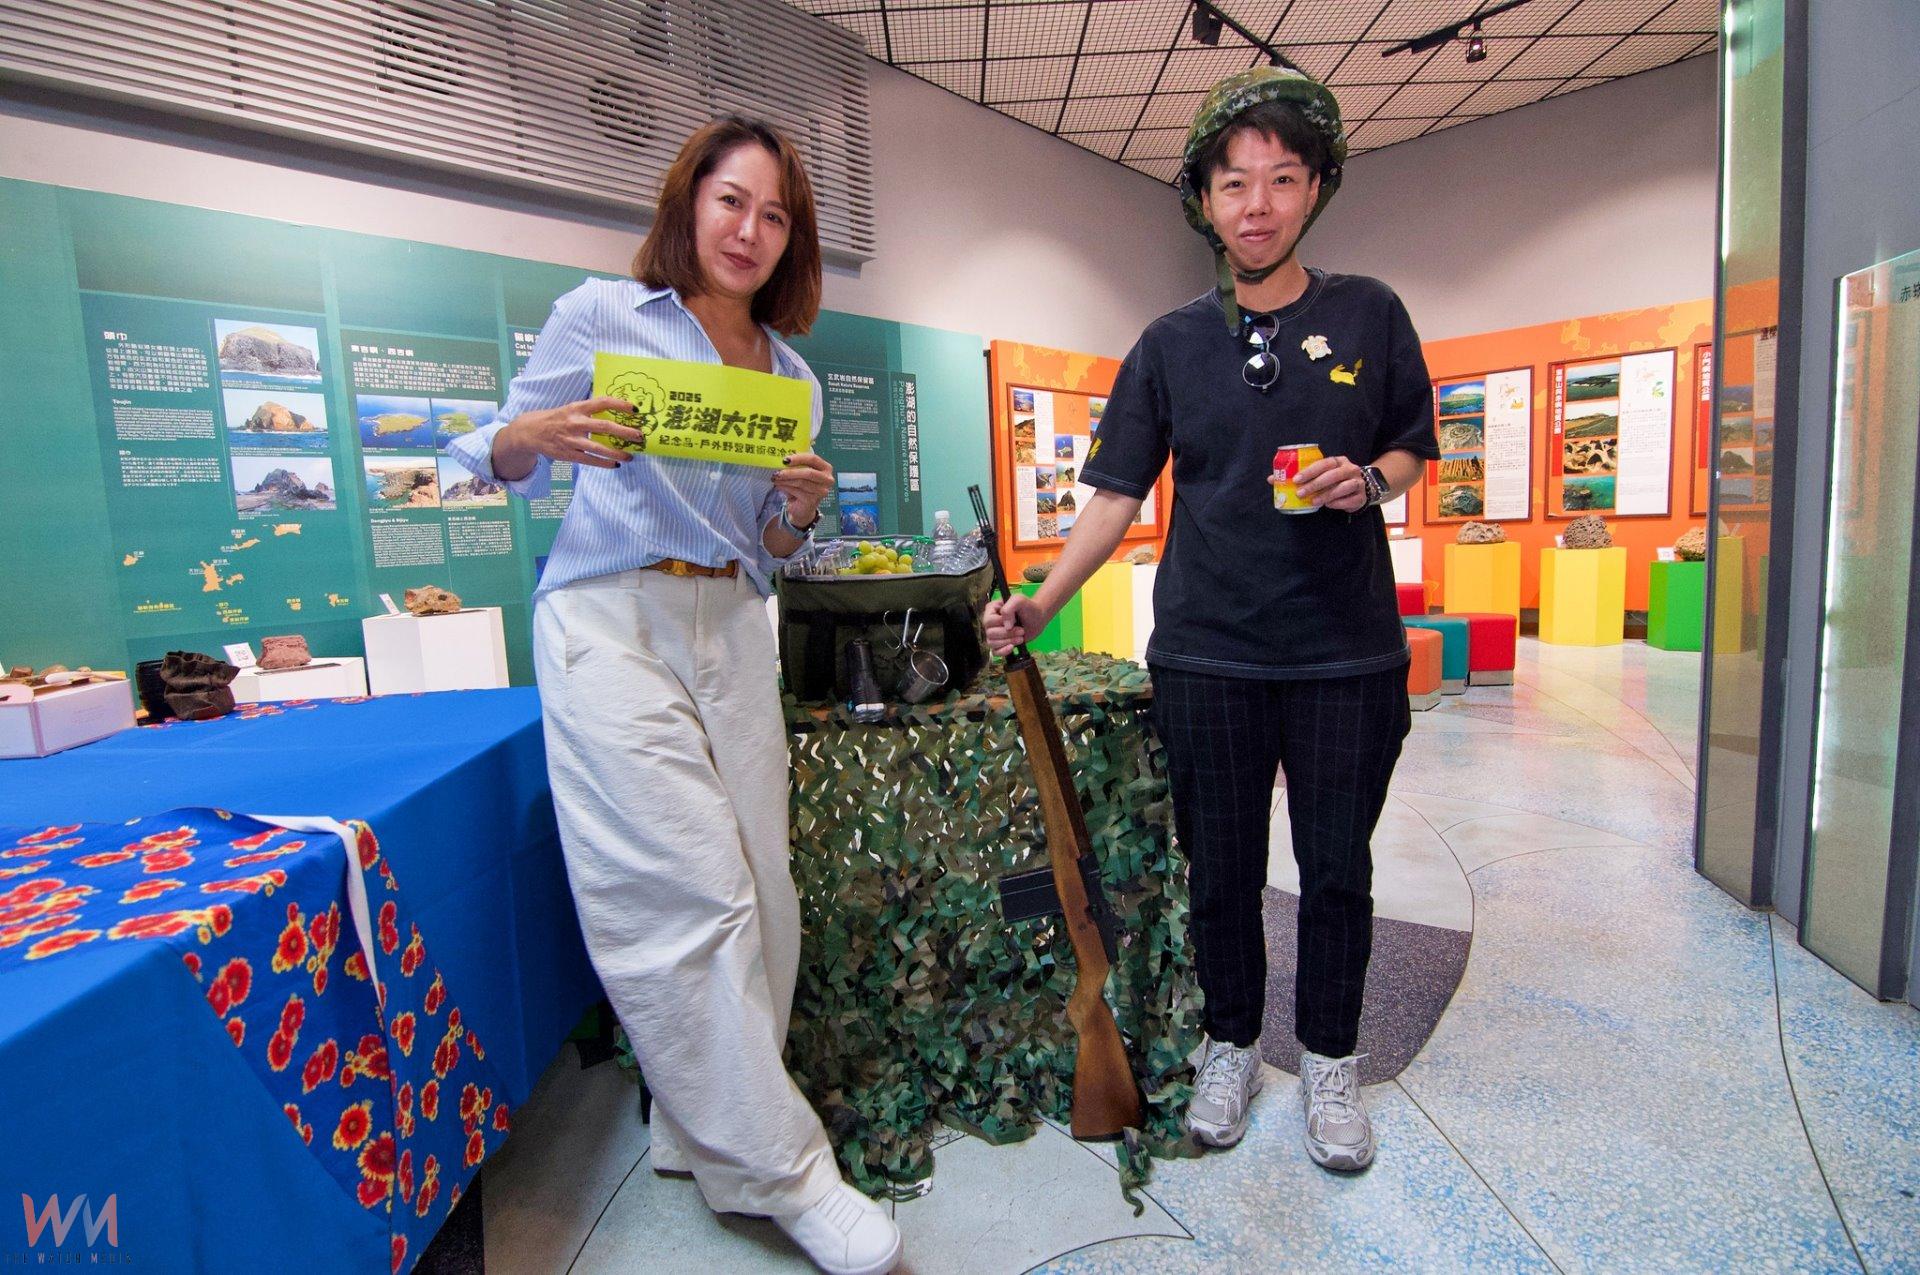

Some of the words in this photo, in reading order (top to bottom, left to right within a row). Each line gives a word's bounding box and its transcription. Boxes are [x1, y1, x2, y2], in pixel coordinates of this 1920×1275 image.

[669, 391, 702, 403] 2025
[661, 404, 798, 443] 澎湖大行軍
